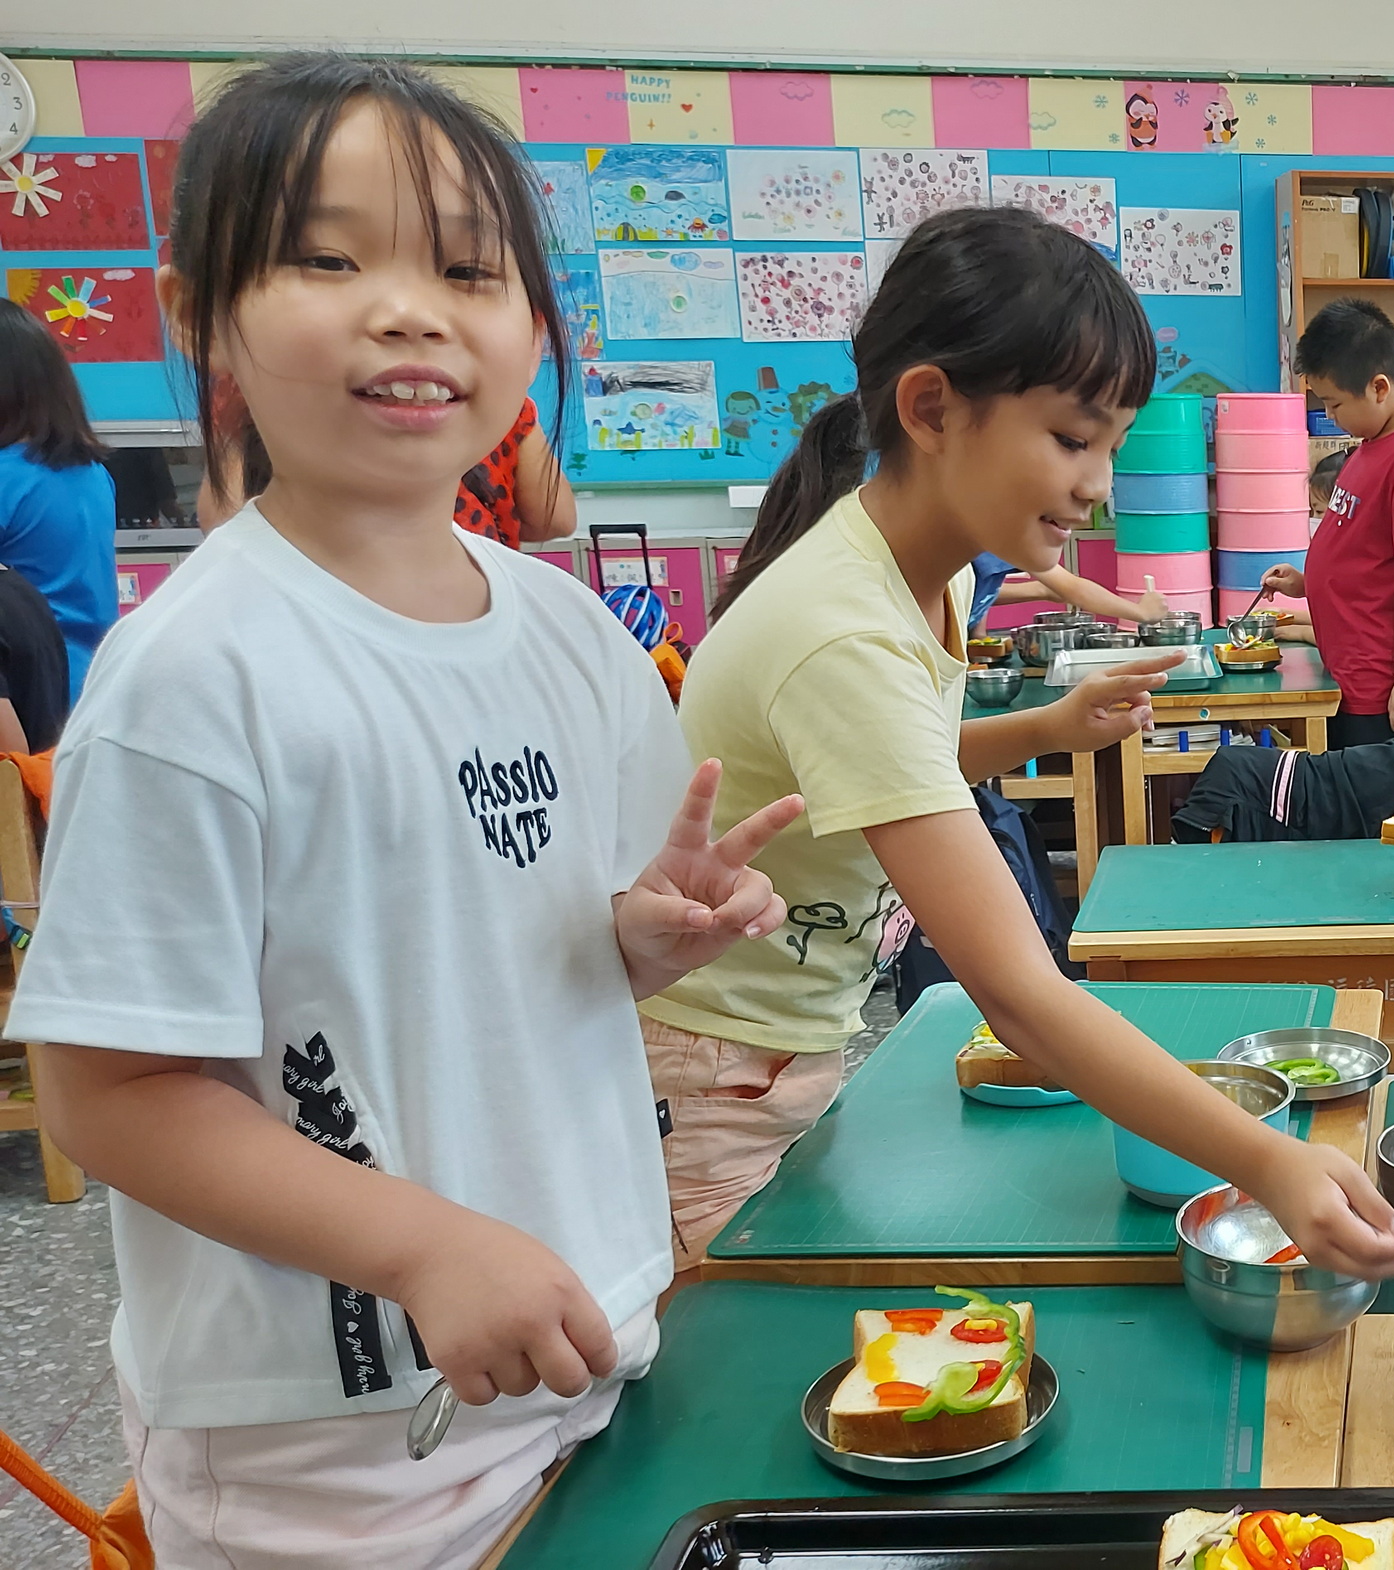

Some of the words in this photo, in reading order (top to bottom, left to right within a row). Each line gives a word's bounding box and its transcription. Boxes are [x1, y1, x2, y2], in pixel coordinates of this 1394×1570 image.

[1, 72, 11, 86] 2
[630, 74, 671, 89] HAPPY
[13, 96, 23, 111] 3
[606, 91, 672, 104] PENGUIN!!
[9, 122, 19, 135] 4
[458, 745, 559, 819] PASSIO
[479, 807, 552, 869] NATE
[296, 1077, 324, 1094] girl
[345, 1336, 373, 1364] girl
